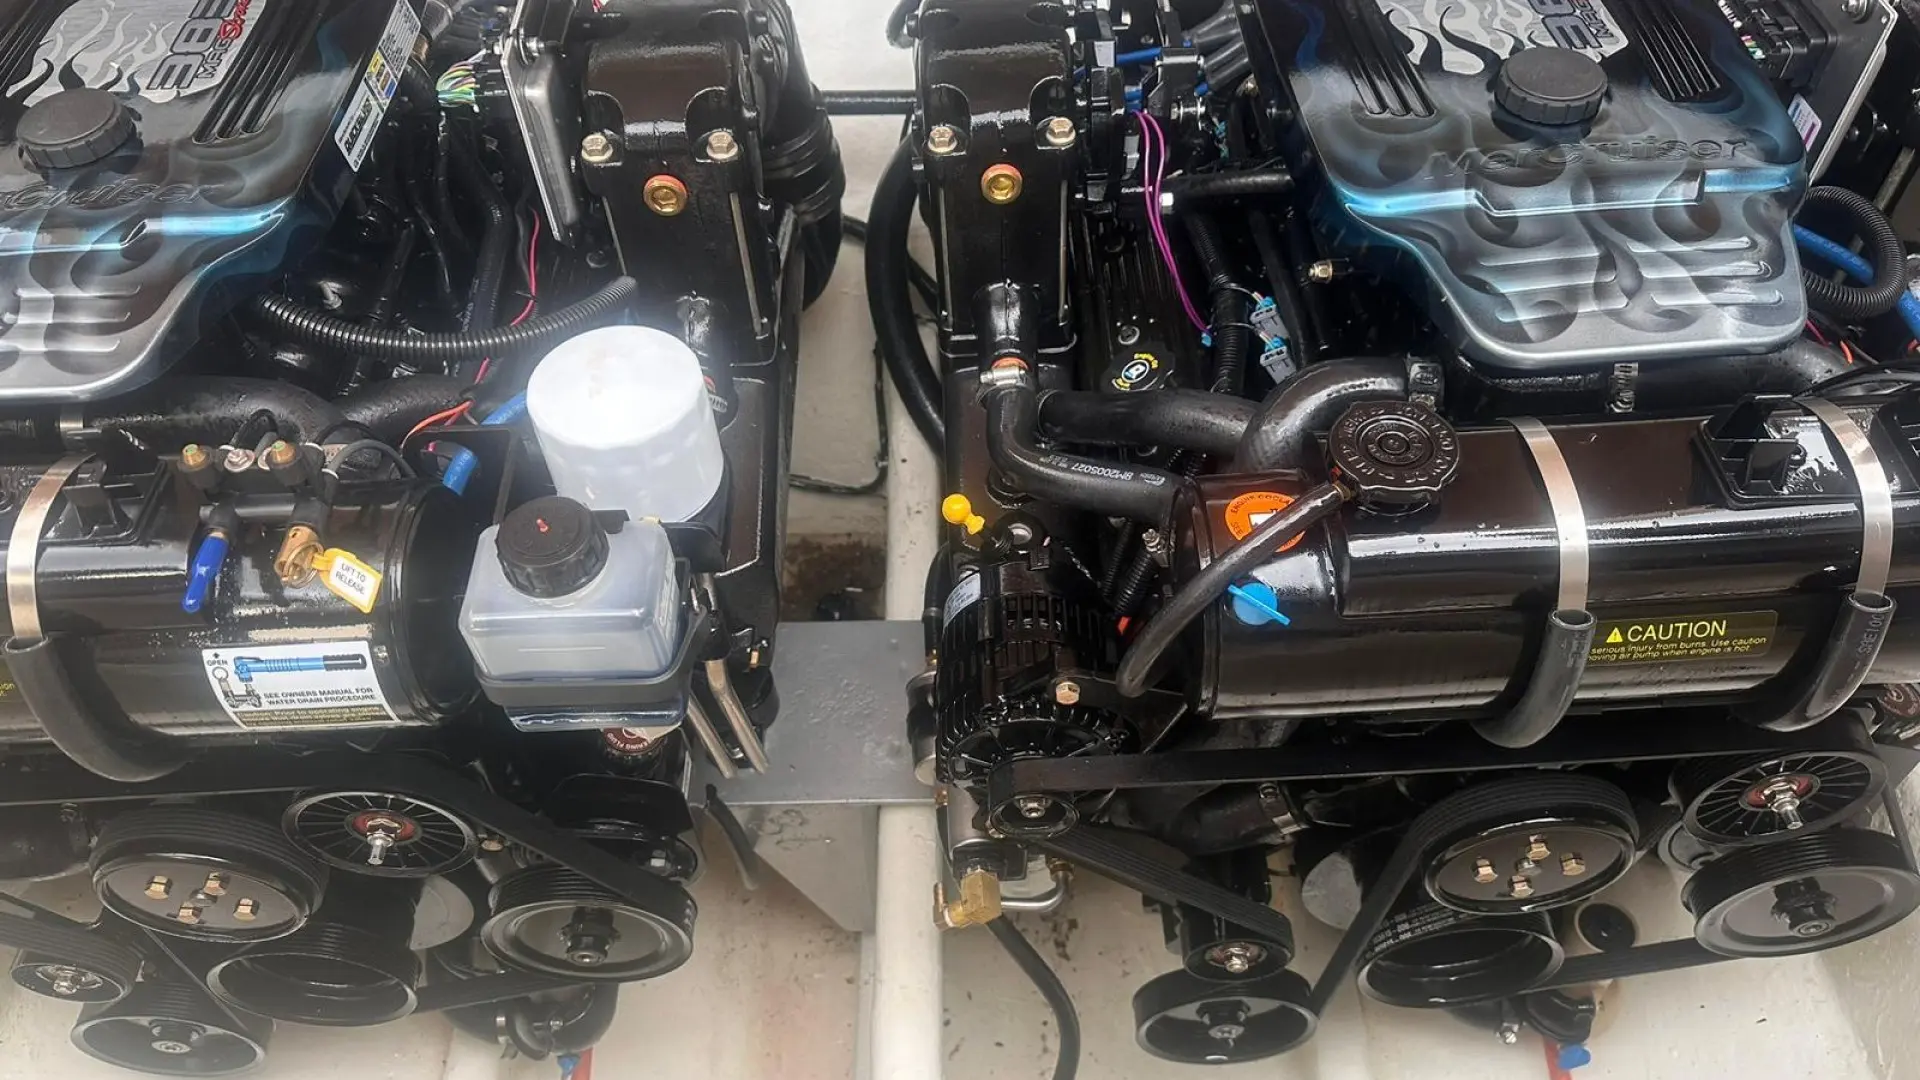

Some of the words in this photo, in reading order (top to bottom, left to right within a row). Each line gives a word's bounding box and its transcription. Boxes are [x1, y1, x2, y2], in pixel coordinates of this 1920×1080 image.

[356, 573, 366, 583] TO
[1627, 619, 1727, 642] CAUTION
[1591, 646, 1626, 655] serious
[1627, 644, 1655, 653] injury
[1656, 642, 1678, 650] from
[1711, 639, 1730, 647] Use
[1732, 637, 1768, 646] caution
[1619, 652, 1632, 660] air
[1632, 650, 1661, 660] pump
[1662, 649, 1688, 657] when
[1689, 646, 1722, 656] engine
[206, 659, 228, 667] OPEN
[281, 690, 318, 698] OWNERS
[318, 688, 354, 696] MANUAL
[267, 697, 296, 705] WATER
[297, 696, 324, 704] DRAIN
[324, 694, 376, 703] PROCEDURE
